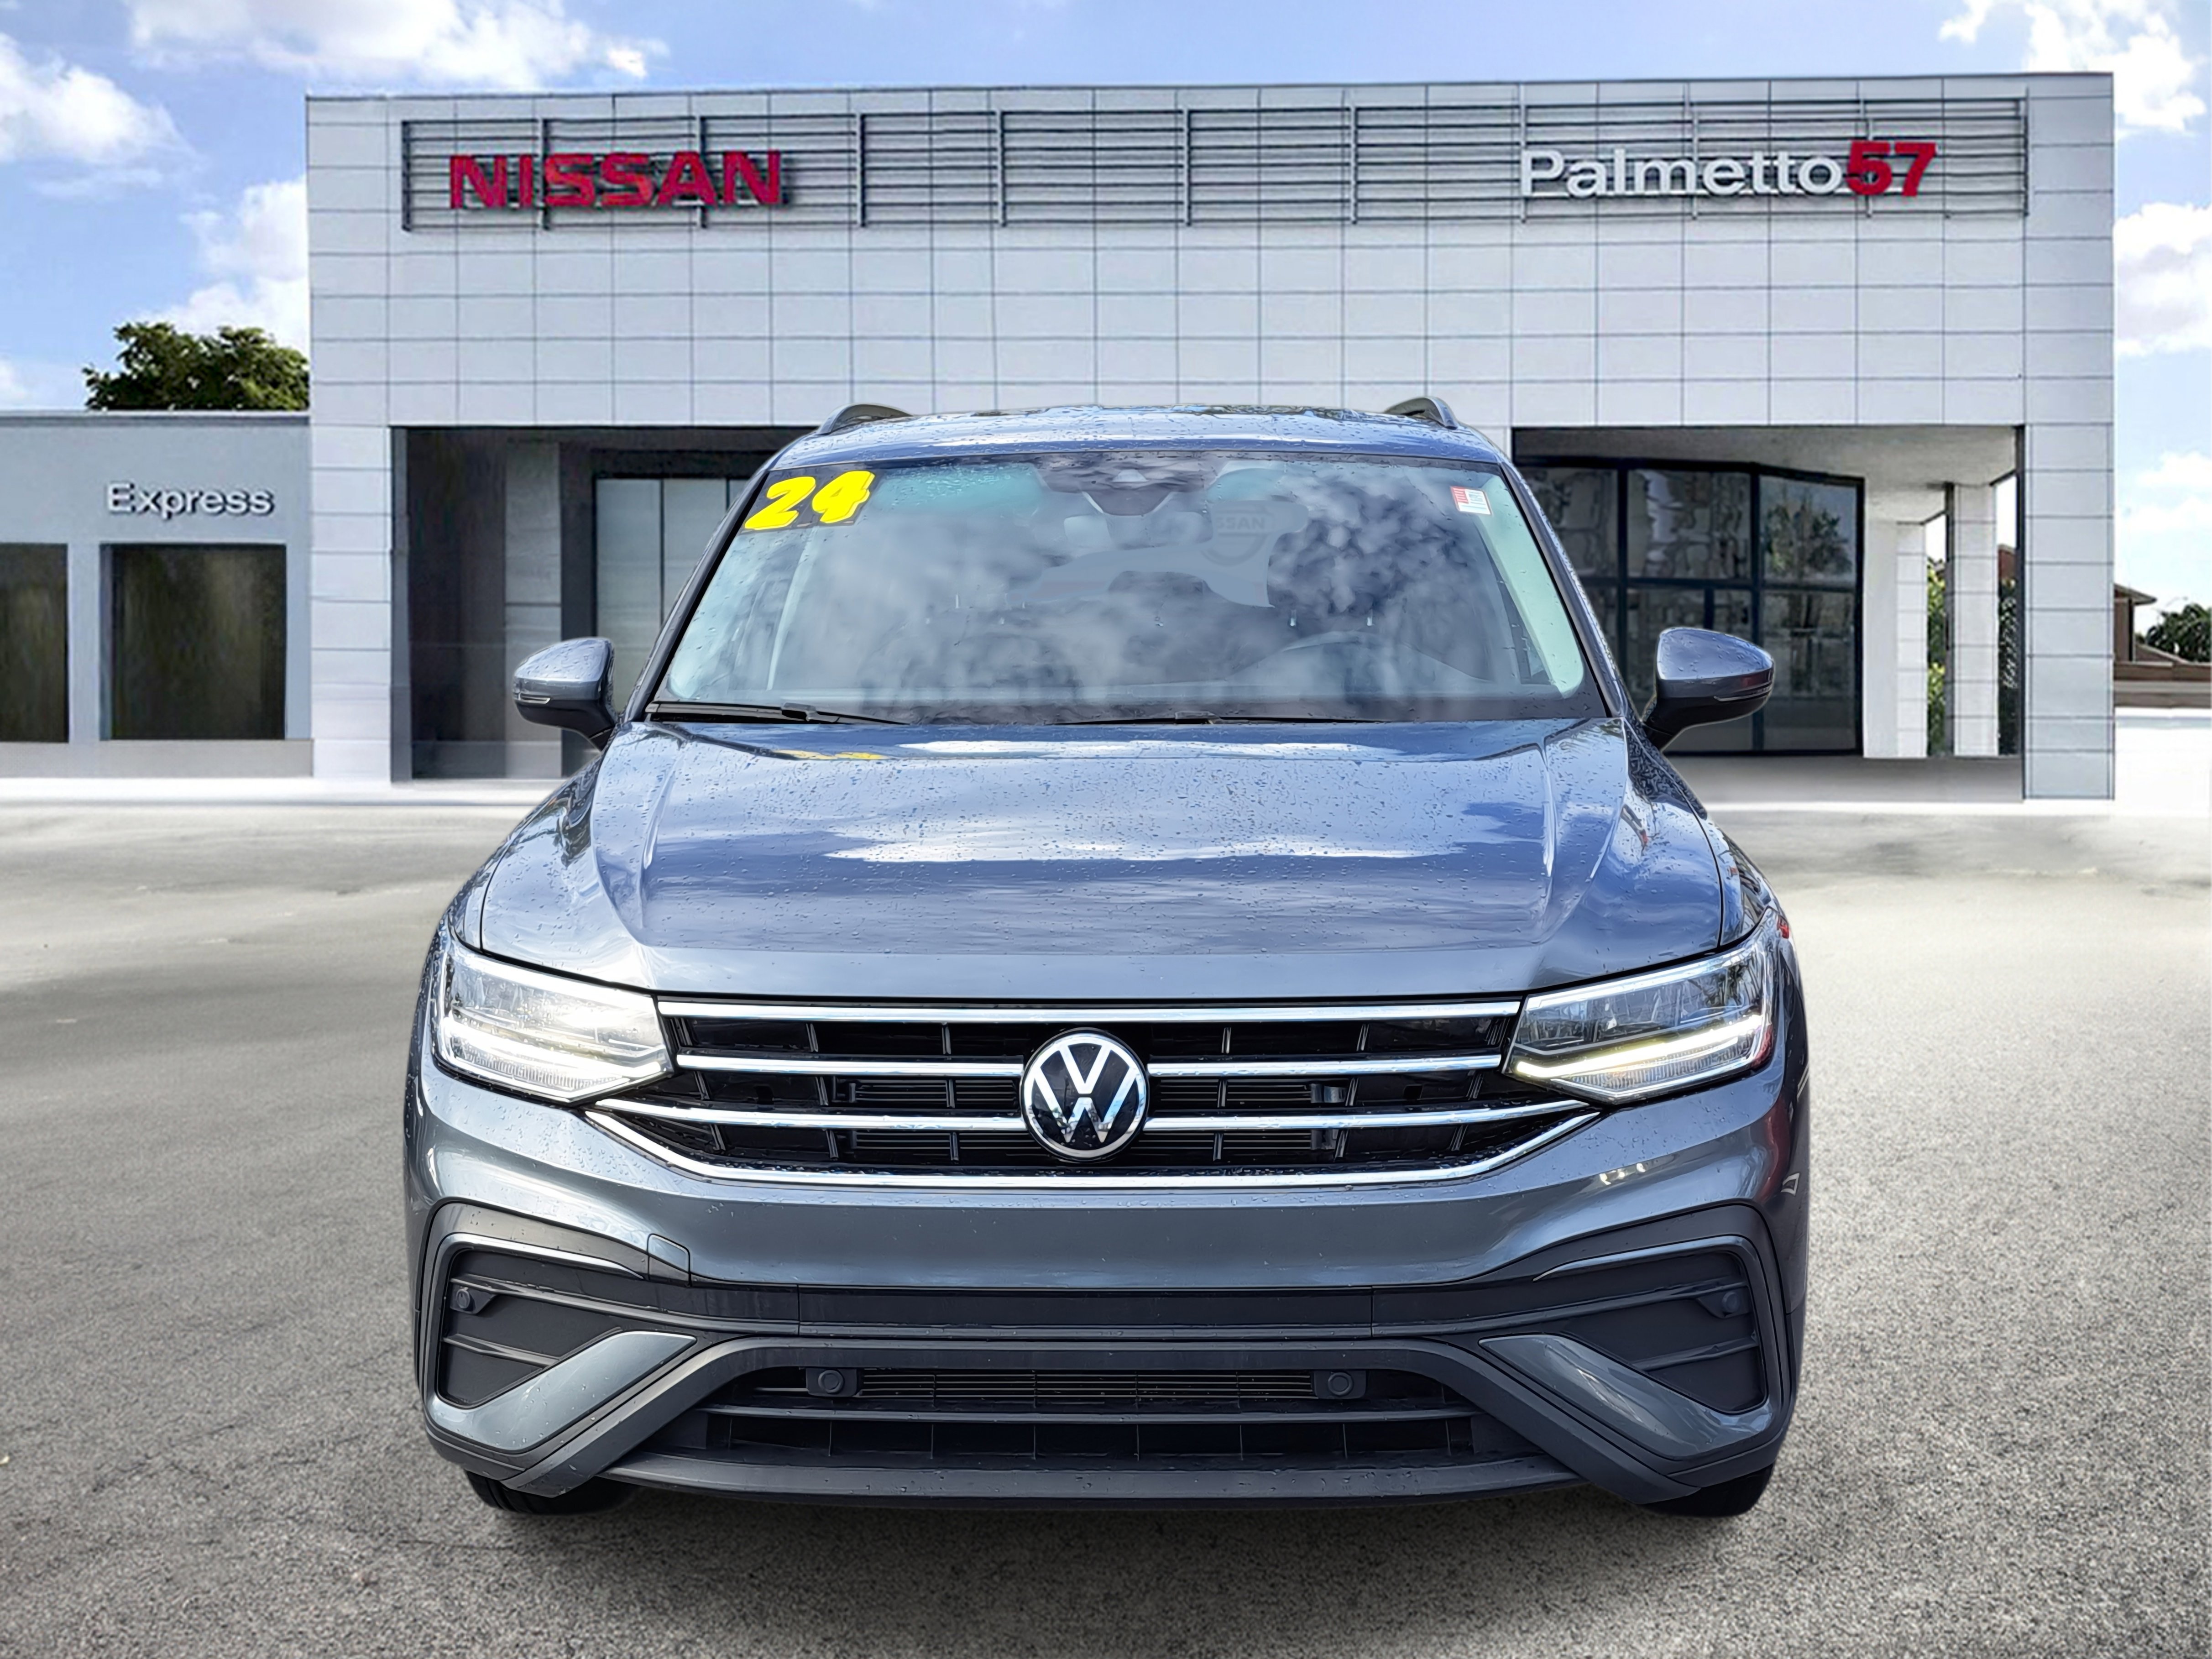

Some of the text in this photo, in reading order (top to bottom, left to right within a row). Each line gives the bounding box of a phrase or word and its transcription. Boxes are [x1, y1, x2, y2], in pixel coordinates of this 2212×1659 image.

[450, 150, 782, 209] NISSAN
[107, 482, 275, 520] Express
[744, 471, 875, 530] 24
[1215, 517, 1265, 529] SSAN
